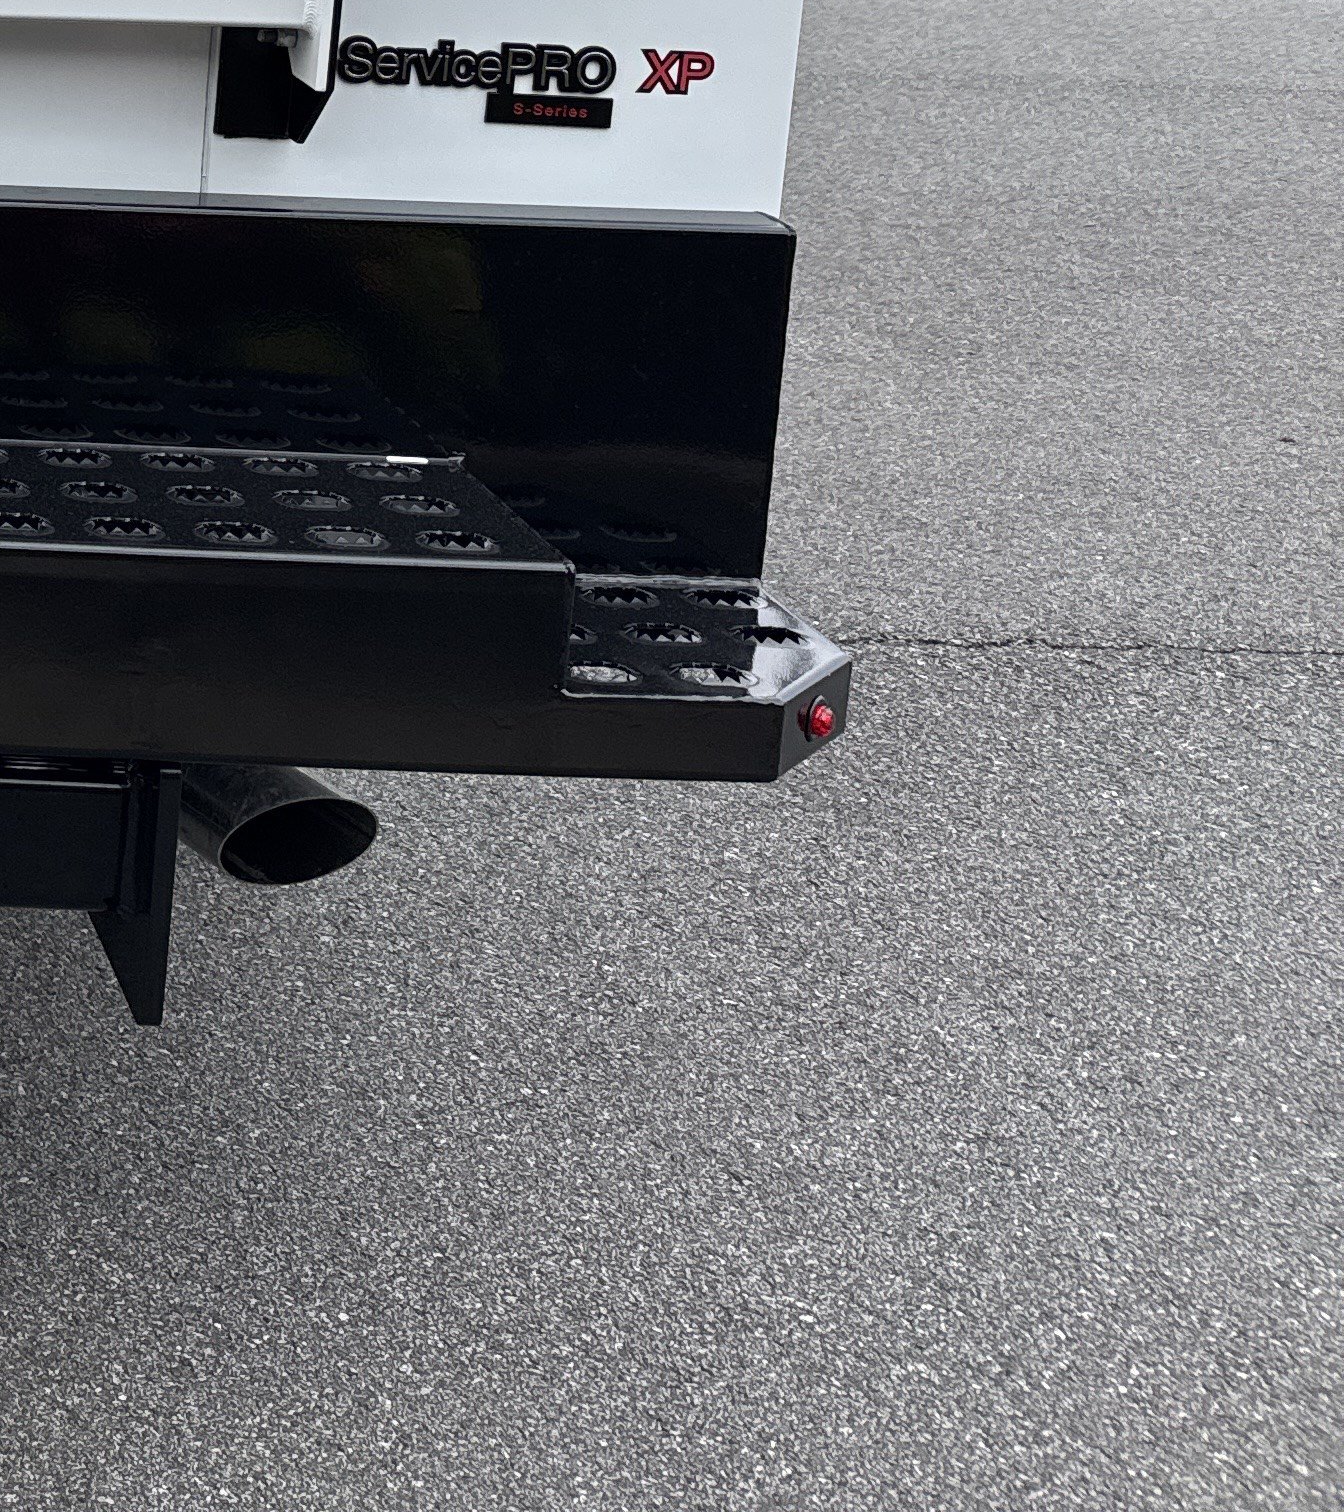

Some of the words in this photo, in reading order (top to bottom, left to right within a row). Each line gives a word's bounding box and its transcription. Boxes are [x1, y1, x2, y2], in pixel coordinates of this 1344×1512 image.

[340, 36, 616, 93] ServicePRO
[635, 48, 716, 95] XP
[513, 102, 588, 119] S-Series
